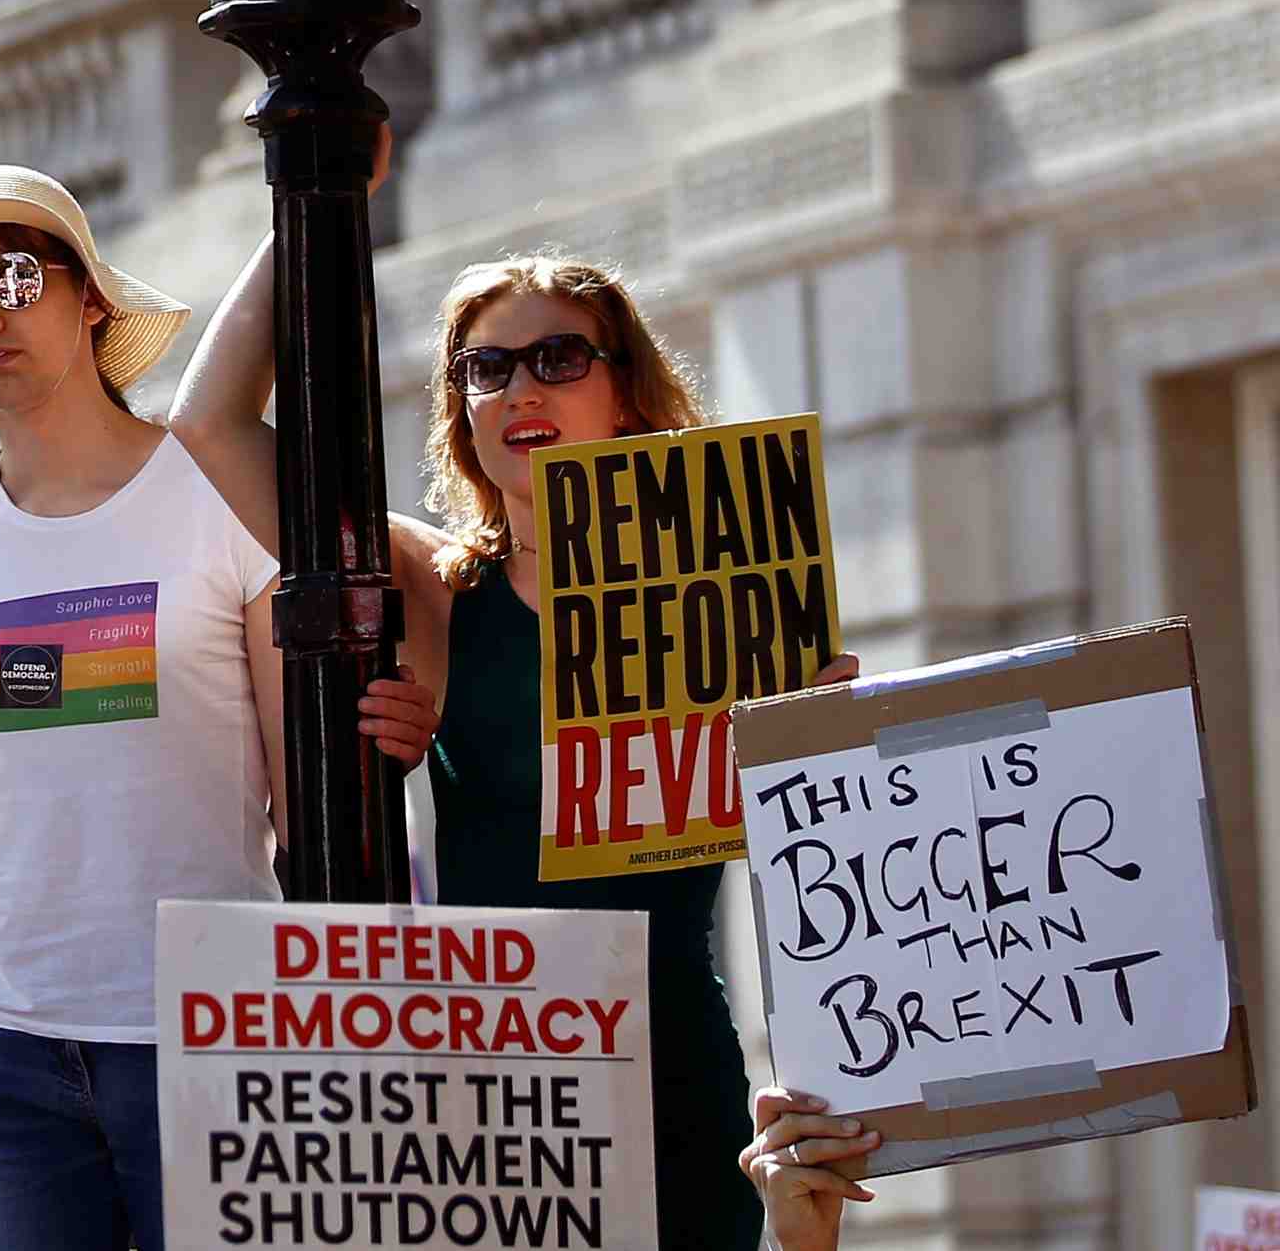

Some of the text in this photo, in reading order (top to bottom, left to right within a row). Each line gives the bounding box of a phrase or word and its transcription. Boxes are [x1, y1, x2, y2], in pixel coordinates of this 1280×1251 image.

[545, 429, 821, 589] REMAIN
[56, 593, 152, 614] Sapphic Love
[89, 623, 149, 641] Fragility
[13, 663, 46, 671] DEFEND
[553, 564, 837, 720] REFORM
[2, 671, 56, 679] DEMOCRACY
[98, 695, 152, 712] Healing
[556, 710, 742, 848] REVO
[757, 743, 1039, 832] THIS IS
[629, 850, 671, 864] ANOTHER
[672, 845, 706, 860] EUROPE
[708, 843, 717, 854] IS
[770, 793, 1142, 962] BIGGER
[274, 924, 535, 983] DEFEND
[898, 907, 1086, 968] THAN
[182, 992, 628, 1054] DEMOCRACY
[819, 950, 1161, 1078] BREXIT
[237, 1071, 580, 1129] RESIST THE
[210, 1132, 612, 1189] PARLIAMENT
[219, 1192, 601, 1249] SHUTDOWN
